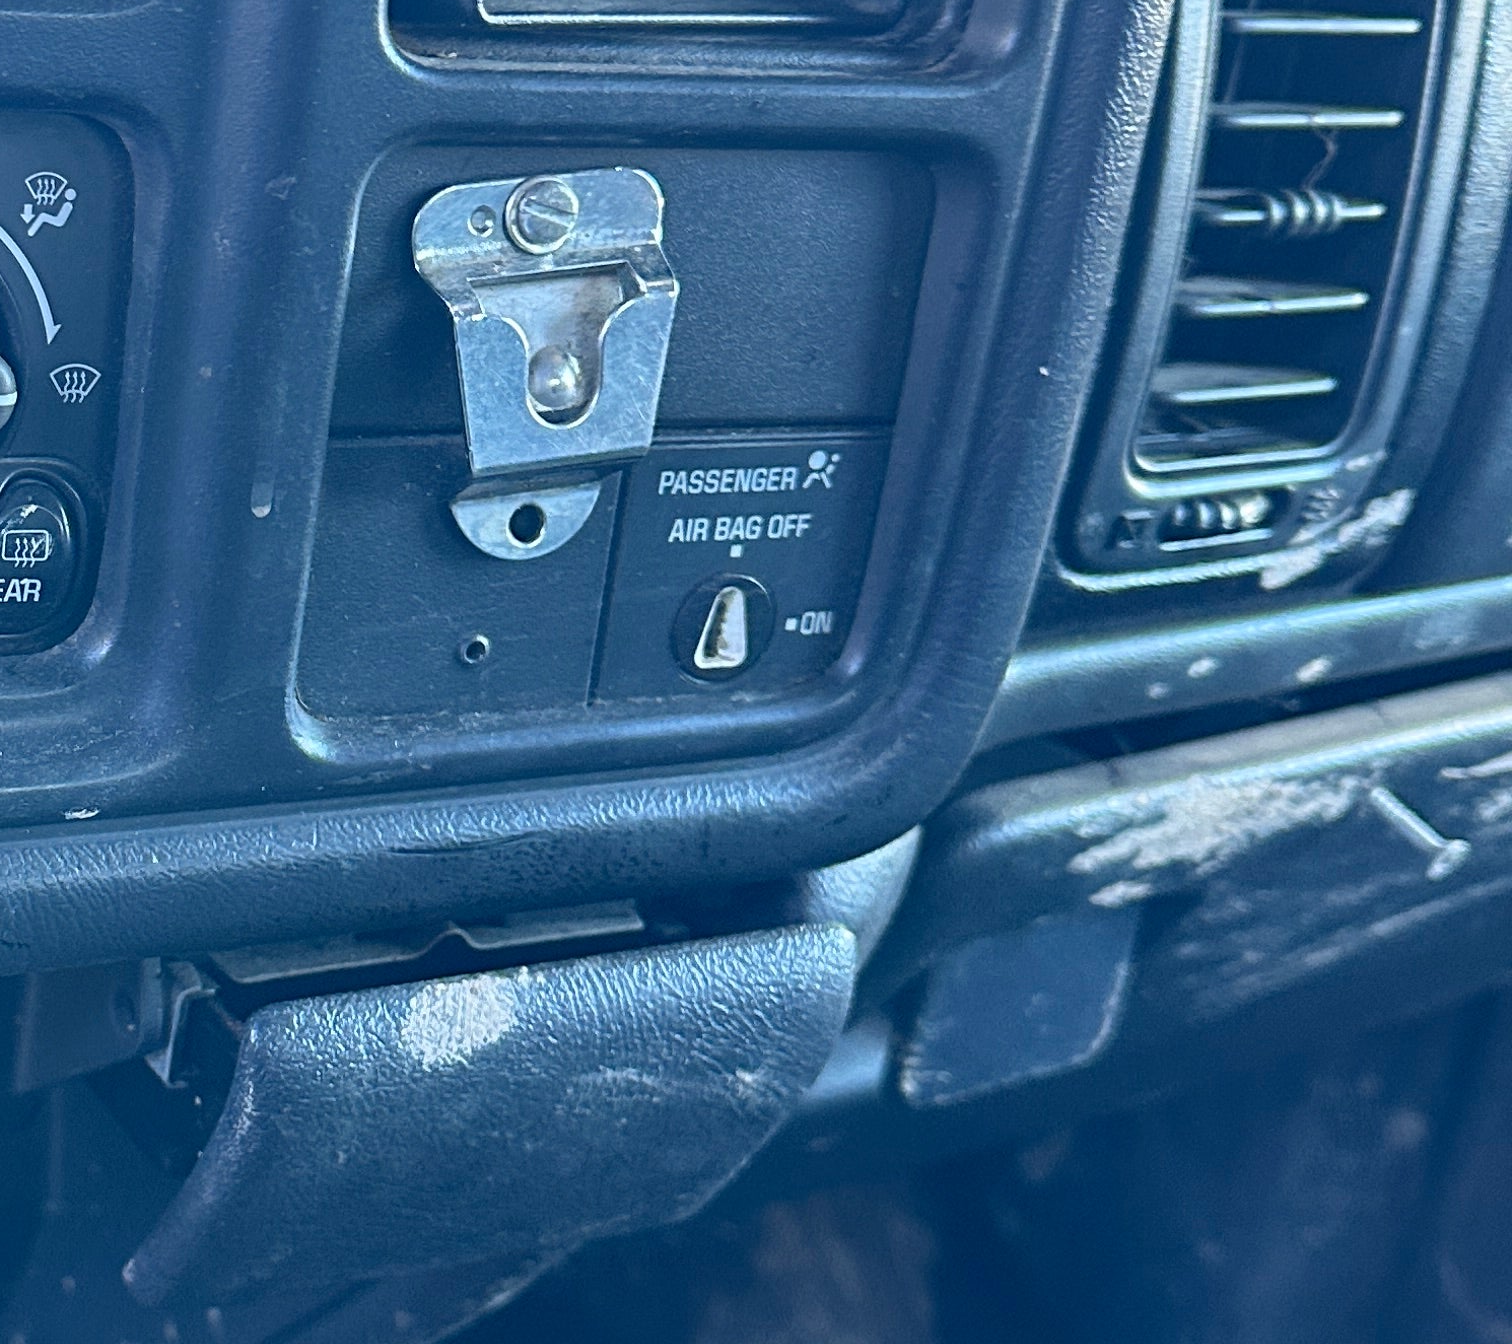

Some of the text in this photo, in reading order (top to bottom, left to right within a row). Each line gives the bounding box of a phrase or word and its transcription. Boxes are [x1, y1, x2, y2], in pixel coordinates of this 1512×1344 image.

[659, 468, 796, 495] PASSENGER
[667, 513, 812, 543] AIR BAG OFF
[800, 611, 832, 634] ON
